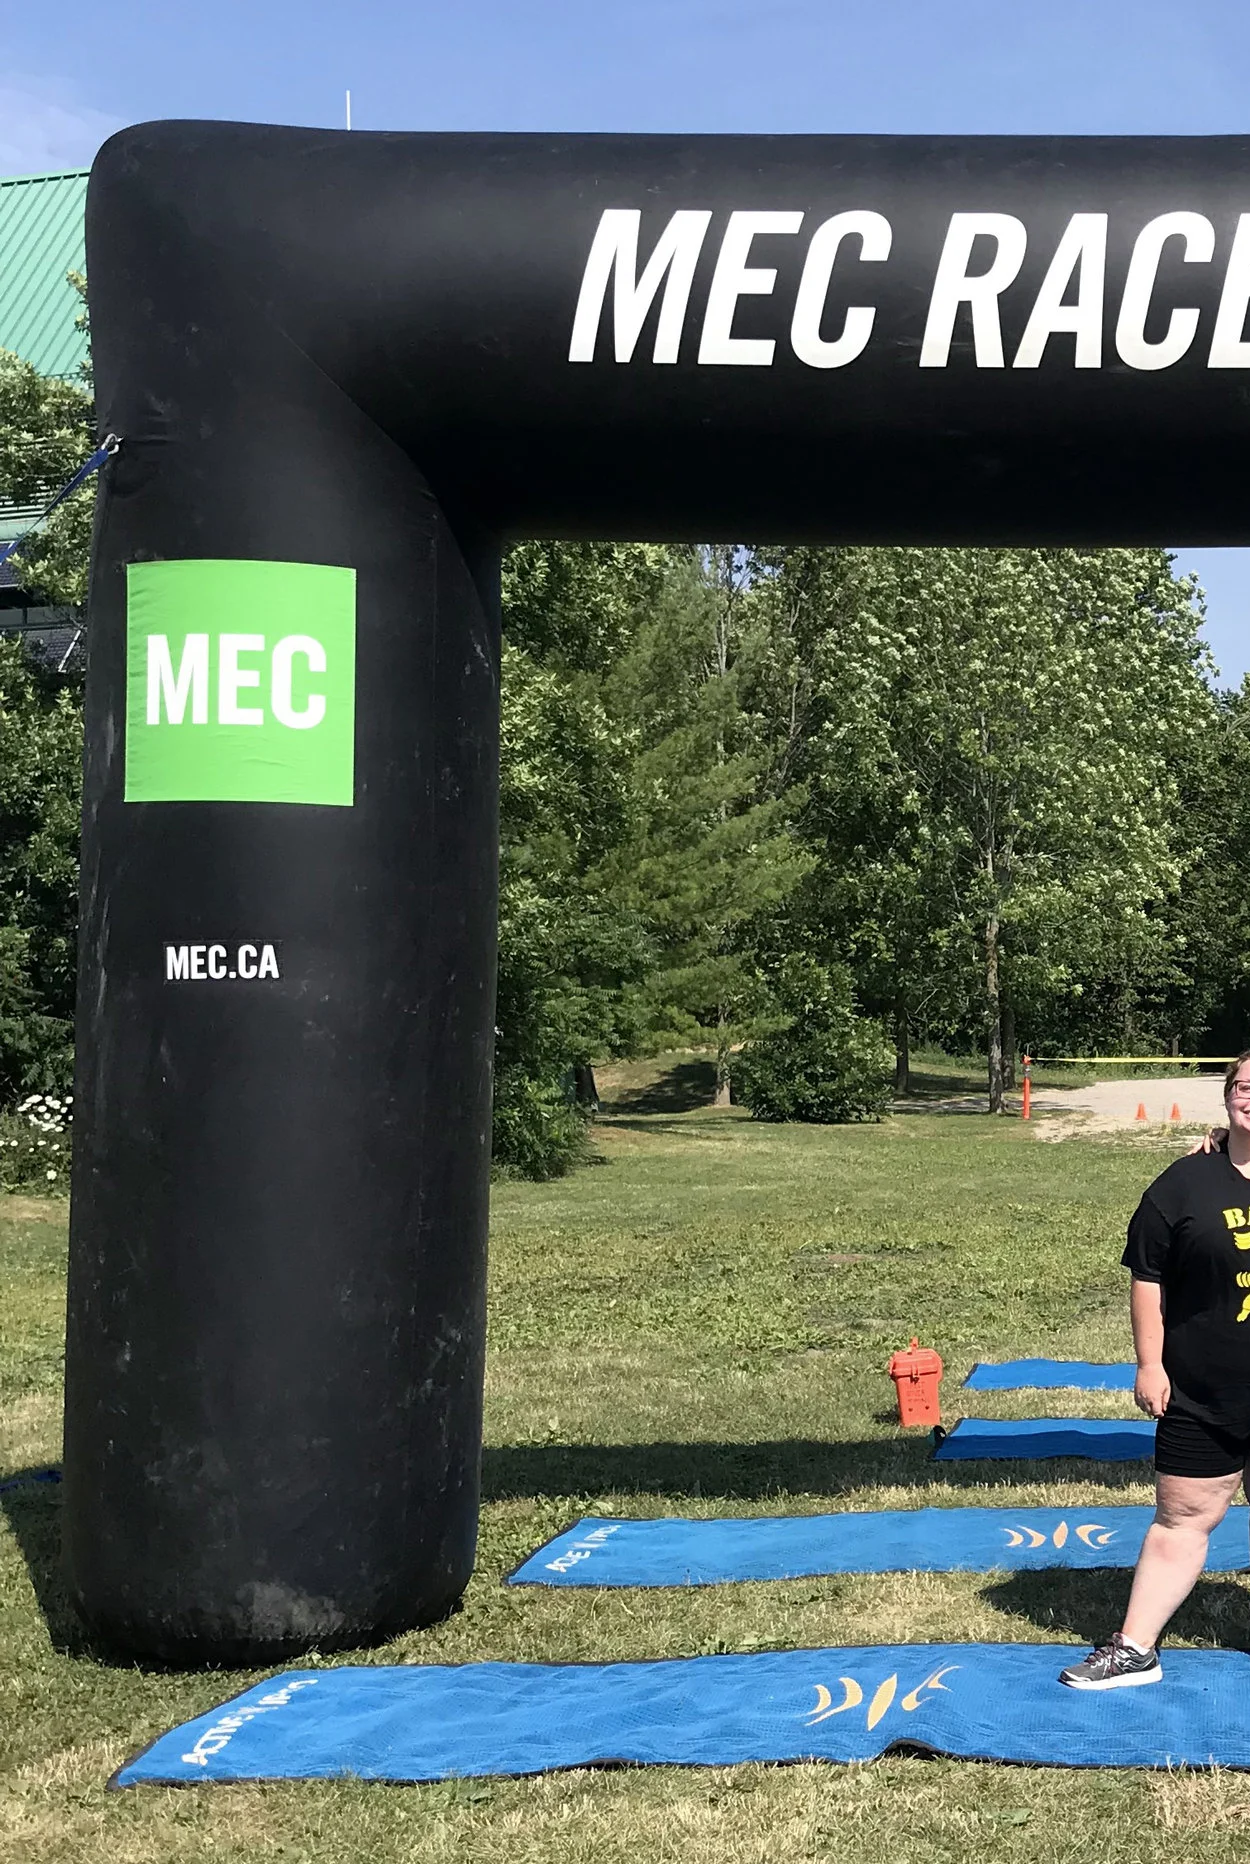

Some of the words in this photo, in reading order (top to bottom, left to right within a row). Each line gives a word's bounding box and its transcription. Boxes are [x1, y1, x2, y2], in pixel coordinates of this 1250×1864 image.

[568, 209, 893, 369] MEC
[145, 633, 328, 730] MEC
[165, 944, 280, 981] MEC.CA
